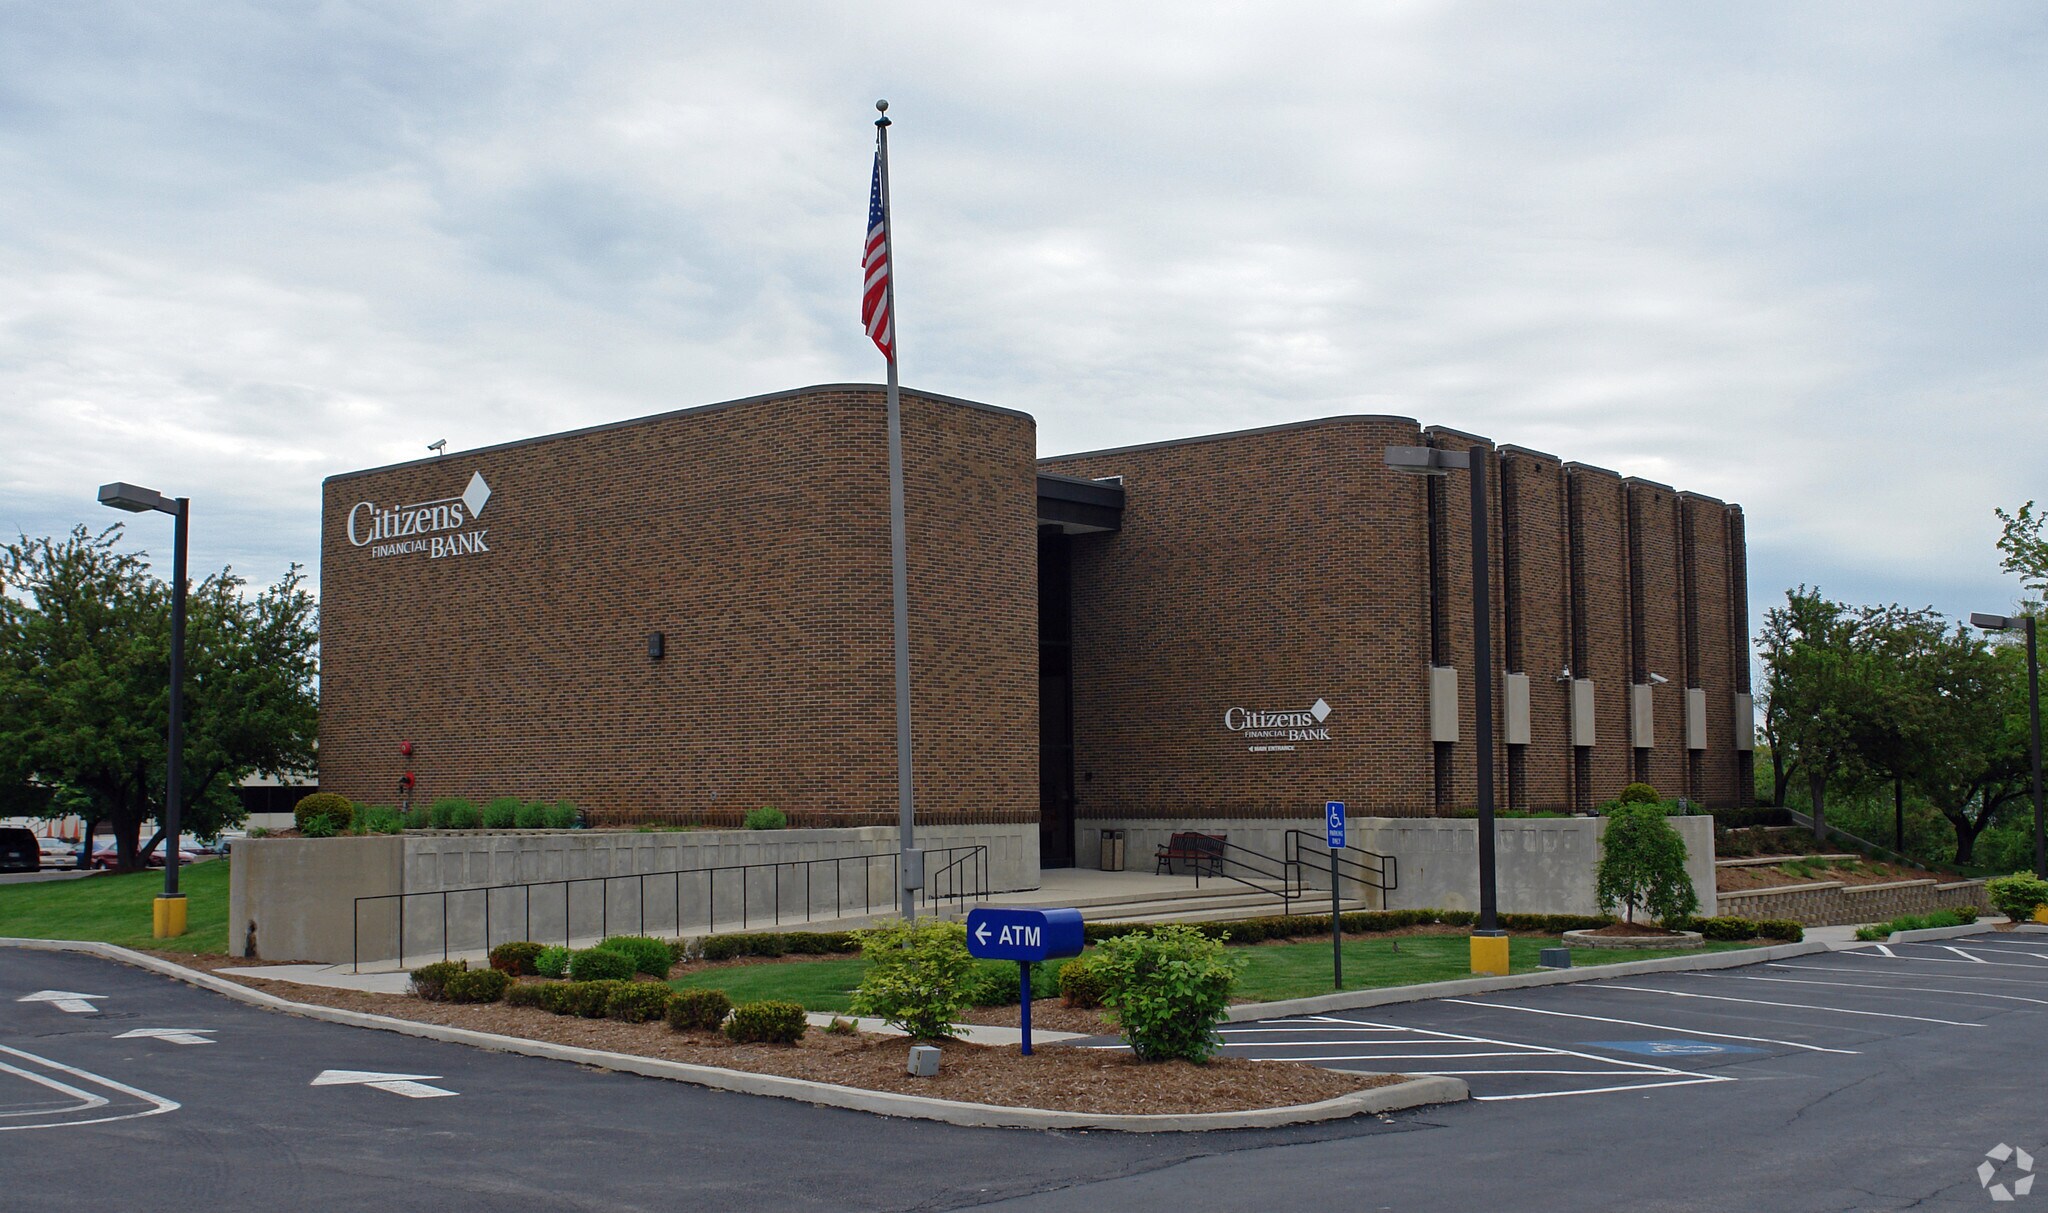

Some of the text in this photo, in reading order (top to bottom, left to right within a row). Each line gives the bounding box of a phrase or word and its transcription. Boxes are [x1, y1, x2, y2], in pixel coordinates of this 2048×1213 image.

[347, 501, 464, 547] Citizens
[372, 530, 490, 559] FINANCIAL BANK
[1224, 706, 1312, 731] Citizens
[1244, 728, 1332, 741] FINANCIAL BANK
[1329, 829, 1343, 837] PARKING
[998, 925, 1041, 947] ATM
